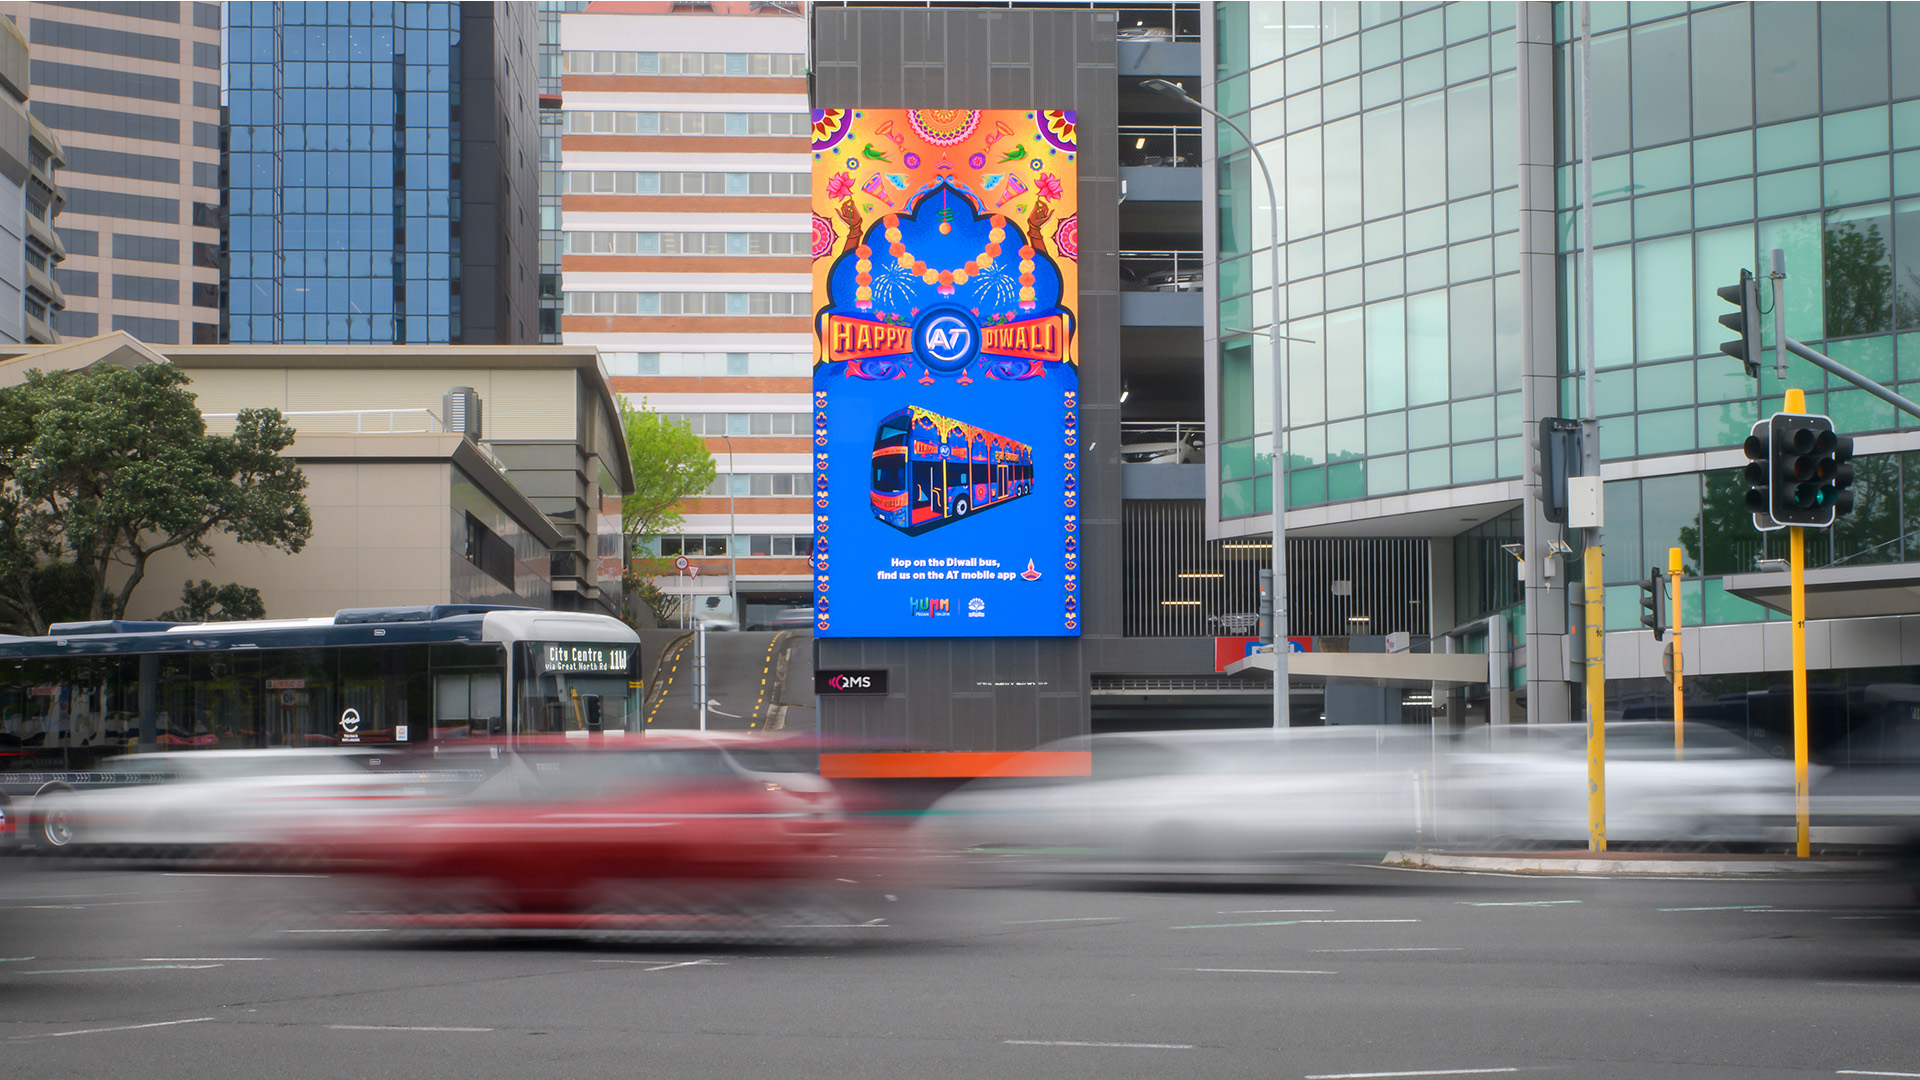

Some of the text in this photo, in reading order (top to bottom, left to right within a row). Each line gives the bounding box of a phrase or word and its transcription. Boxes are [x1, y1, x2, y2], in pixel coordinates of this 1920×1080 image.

[833, 321, 1056, 353] HAPPY DIWALI
[928, 328, 968, 350] AT
[891, 557, 1000, 569] Hop on the Diwali bus,
[877, 570, 1017, 581] find us on the AT mobile app
[910, 597, 950, 618] HUMM
[549, 647, 603, 662] City Centre
[609, 650, 627, 670] 11W
[545, 662, 608, 671] via Great North Rd
[836, 675, 871, 690] QMS
